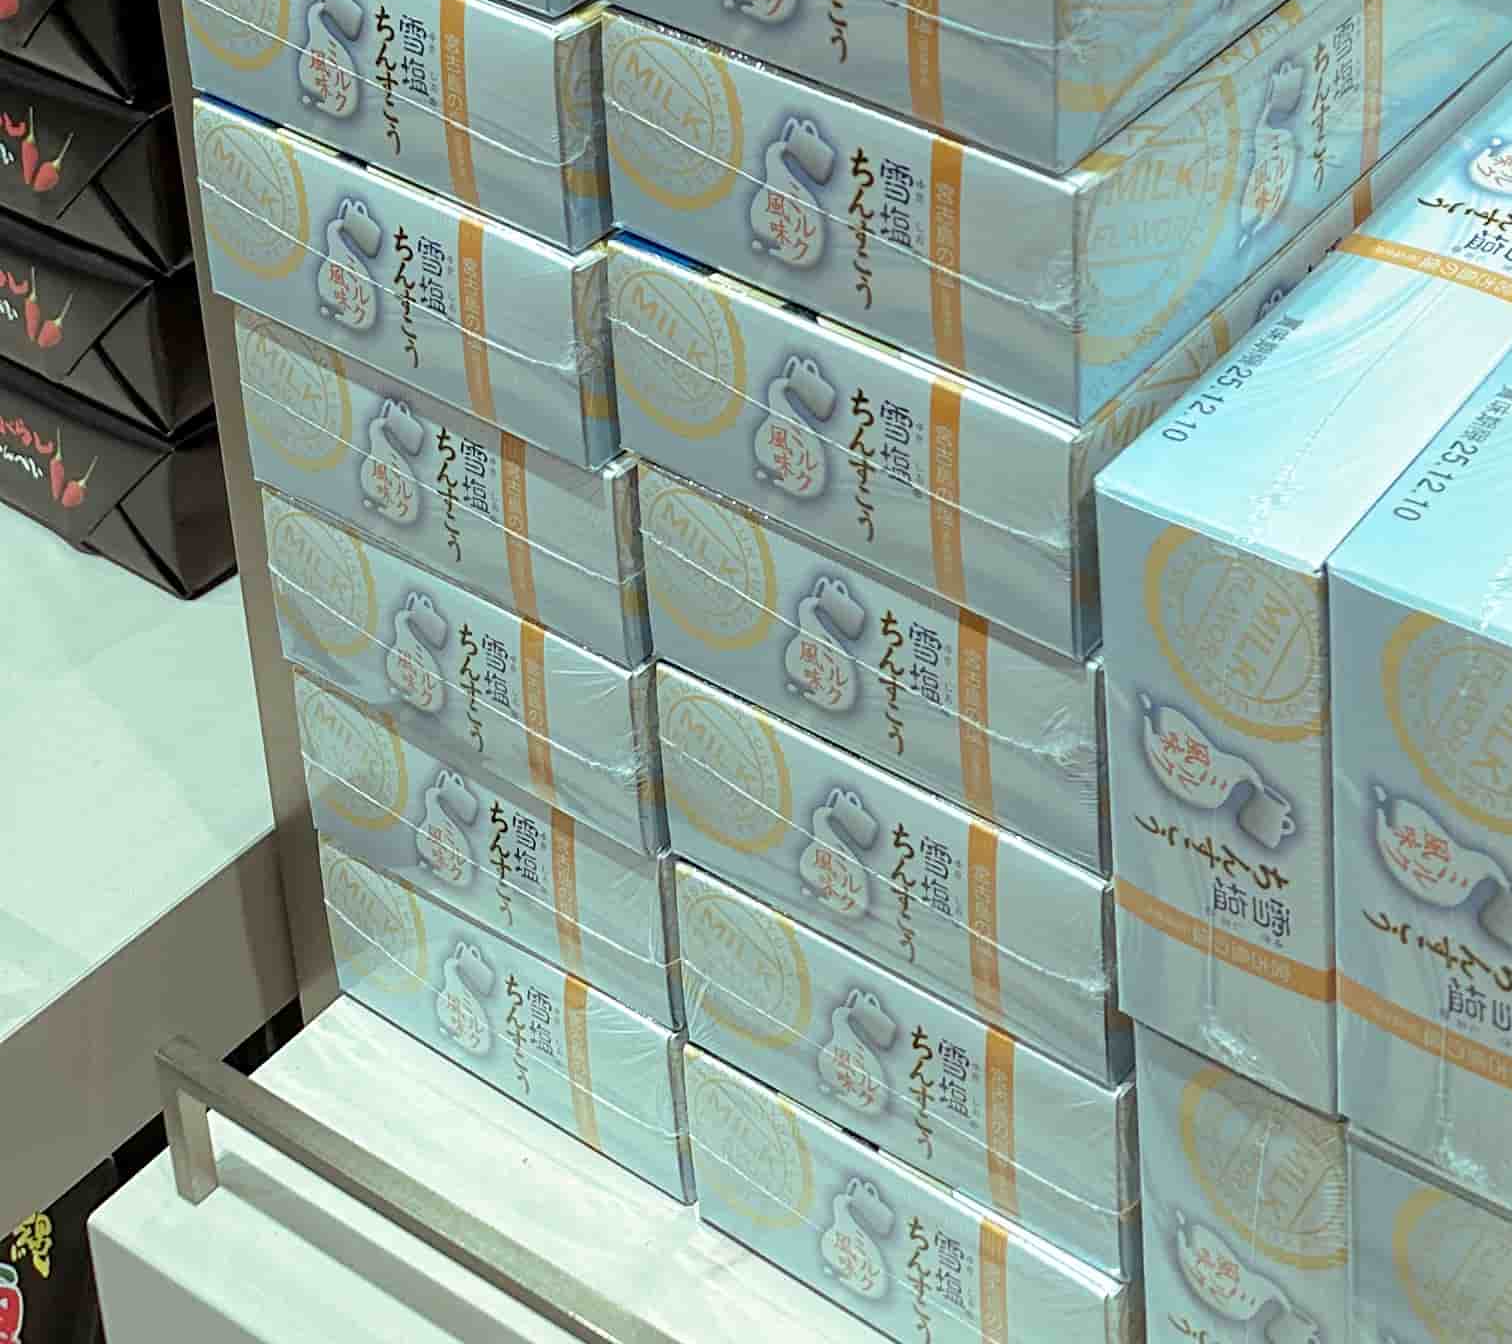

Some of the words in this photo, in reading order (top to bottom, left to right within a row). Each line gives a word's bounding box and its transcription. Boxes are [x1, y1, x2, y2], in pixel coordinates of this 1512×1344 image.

[375, 5, 401, 156] ちんすこう
[625, 51, 707, 139] MILK
[848, 148, 876, 312] ちんすこう
[393, 224, 421, 369] ちんすこう
[632, 284, 707, 365] MILK
[1161, 363, 1255, 444] 25.12.10
[848, 387, 877, 544] ちんすこう
[1392, 438, 1479, 523] 25.12.10
[878, 608, 906, 758] ちんすこう
[1232, 588, 1292, 685] MILK
[1134, 813, 1292, 892] ちんすこう
